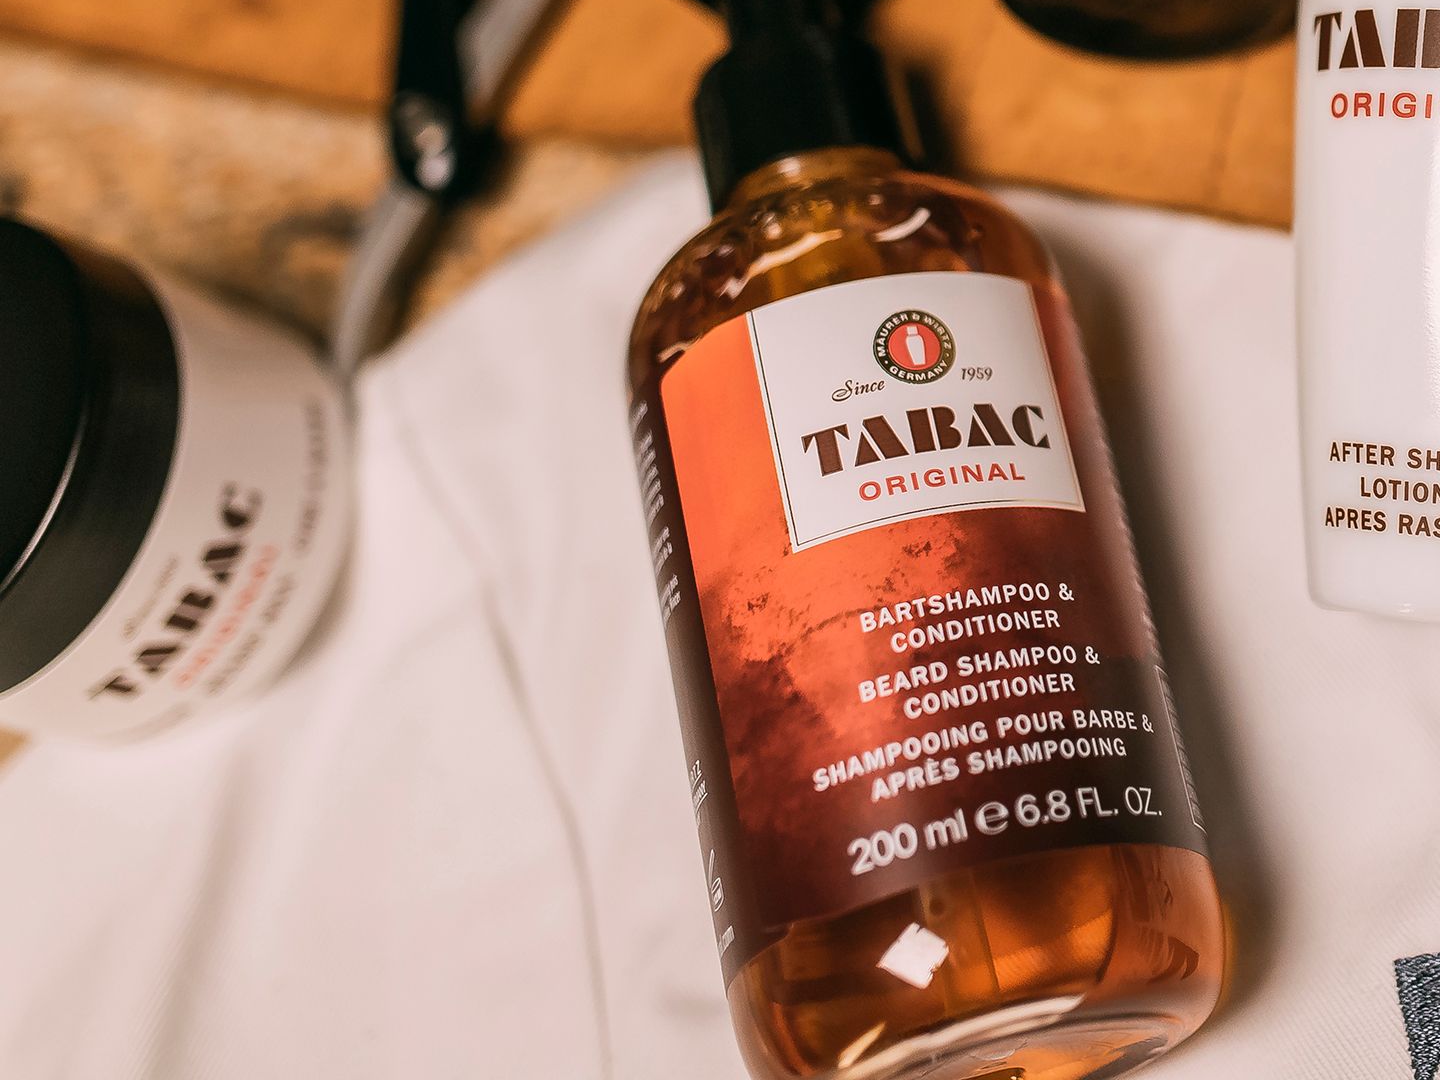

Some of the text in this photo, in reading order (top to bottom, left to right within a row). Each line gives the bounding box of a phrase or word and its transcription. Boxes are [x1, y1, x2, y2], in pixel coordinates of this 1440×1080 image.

[877, 313, 908, 357] MAURER
[831, 366, 993, 402] Since 1959
[889, 360, 948, 381] GERMANY
[801, 403, 1051, 477] TABAC
[1329, 441, 1395, 467] AFTER
[859, 462, 1026, 502] ORIGINAL
[1325, 506, 1387, 532] APRES
[859, 582, 1075, 633] BARTSHAMPOO &
[890, 609, 1061, 654] CONDITIONER
[858, 645, 1100, 704] BEARD SHAMPOO &
[903, 673, 1076, 720] CONDITIONER
[812, 709, 1154, 792] SHAMPOOING POUR BARBE &
[870, 737, 1127, 803] APRÈS SHAMPOOING
[847, 823, 919, 876] 200
[924, 808, 968, 850] ml
[1014, 790, 1072, 828] 6.8
[1076, 787, 1119, 818] FL.
[1124, 787, 1163, 817] OZ.
